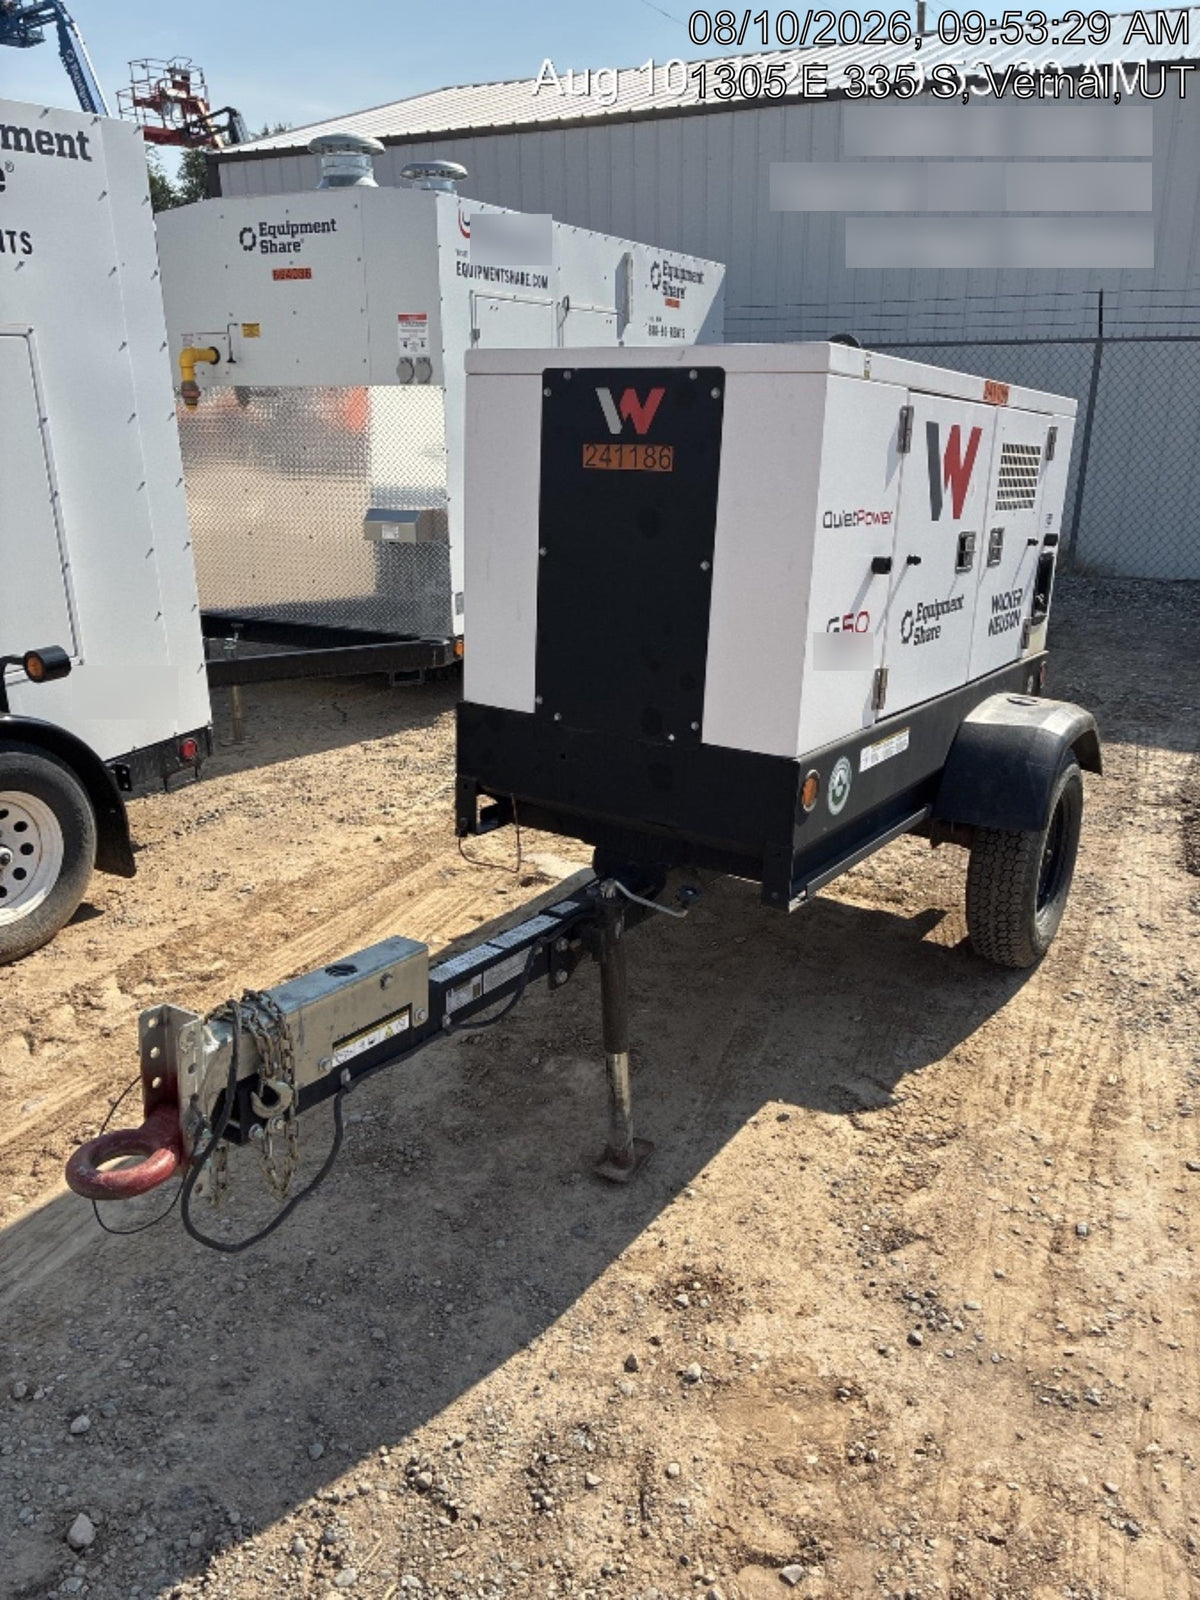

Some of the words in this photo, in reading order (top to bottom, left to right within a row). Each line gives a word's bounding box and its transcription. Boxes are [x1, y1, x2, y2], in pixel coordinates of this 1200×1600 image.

[259, 218, 337, 238] Equipment
[584, 444, 672, 469] 241186
[823, 509, 893, 528] QuietPower
[915, 594, 964, 624] Equipment
[913, 625, 942, 645] Share
